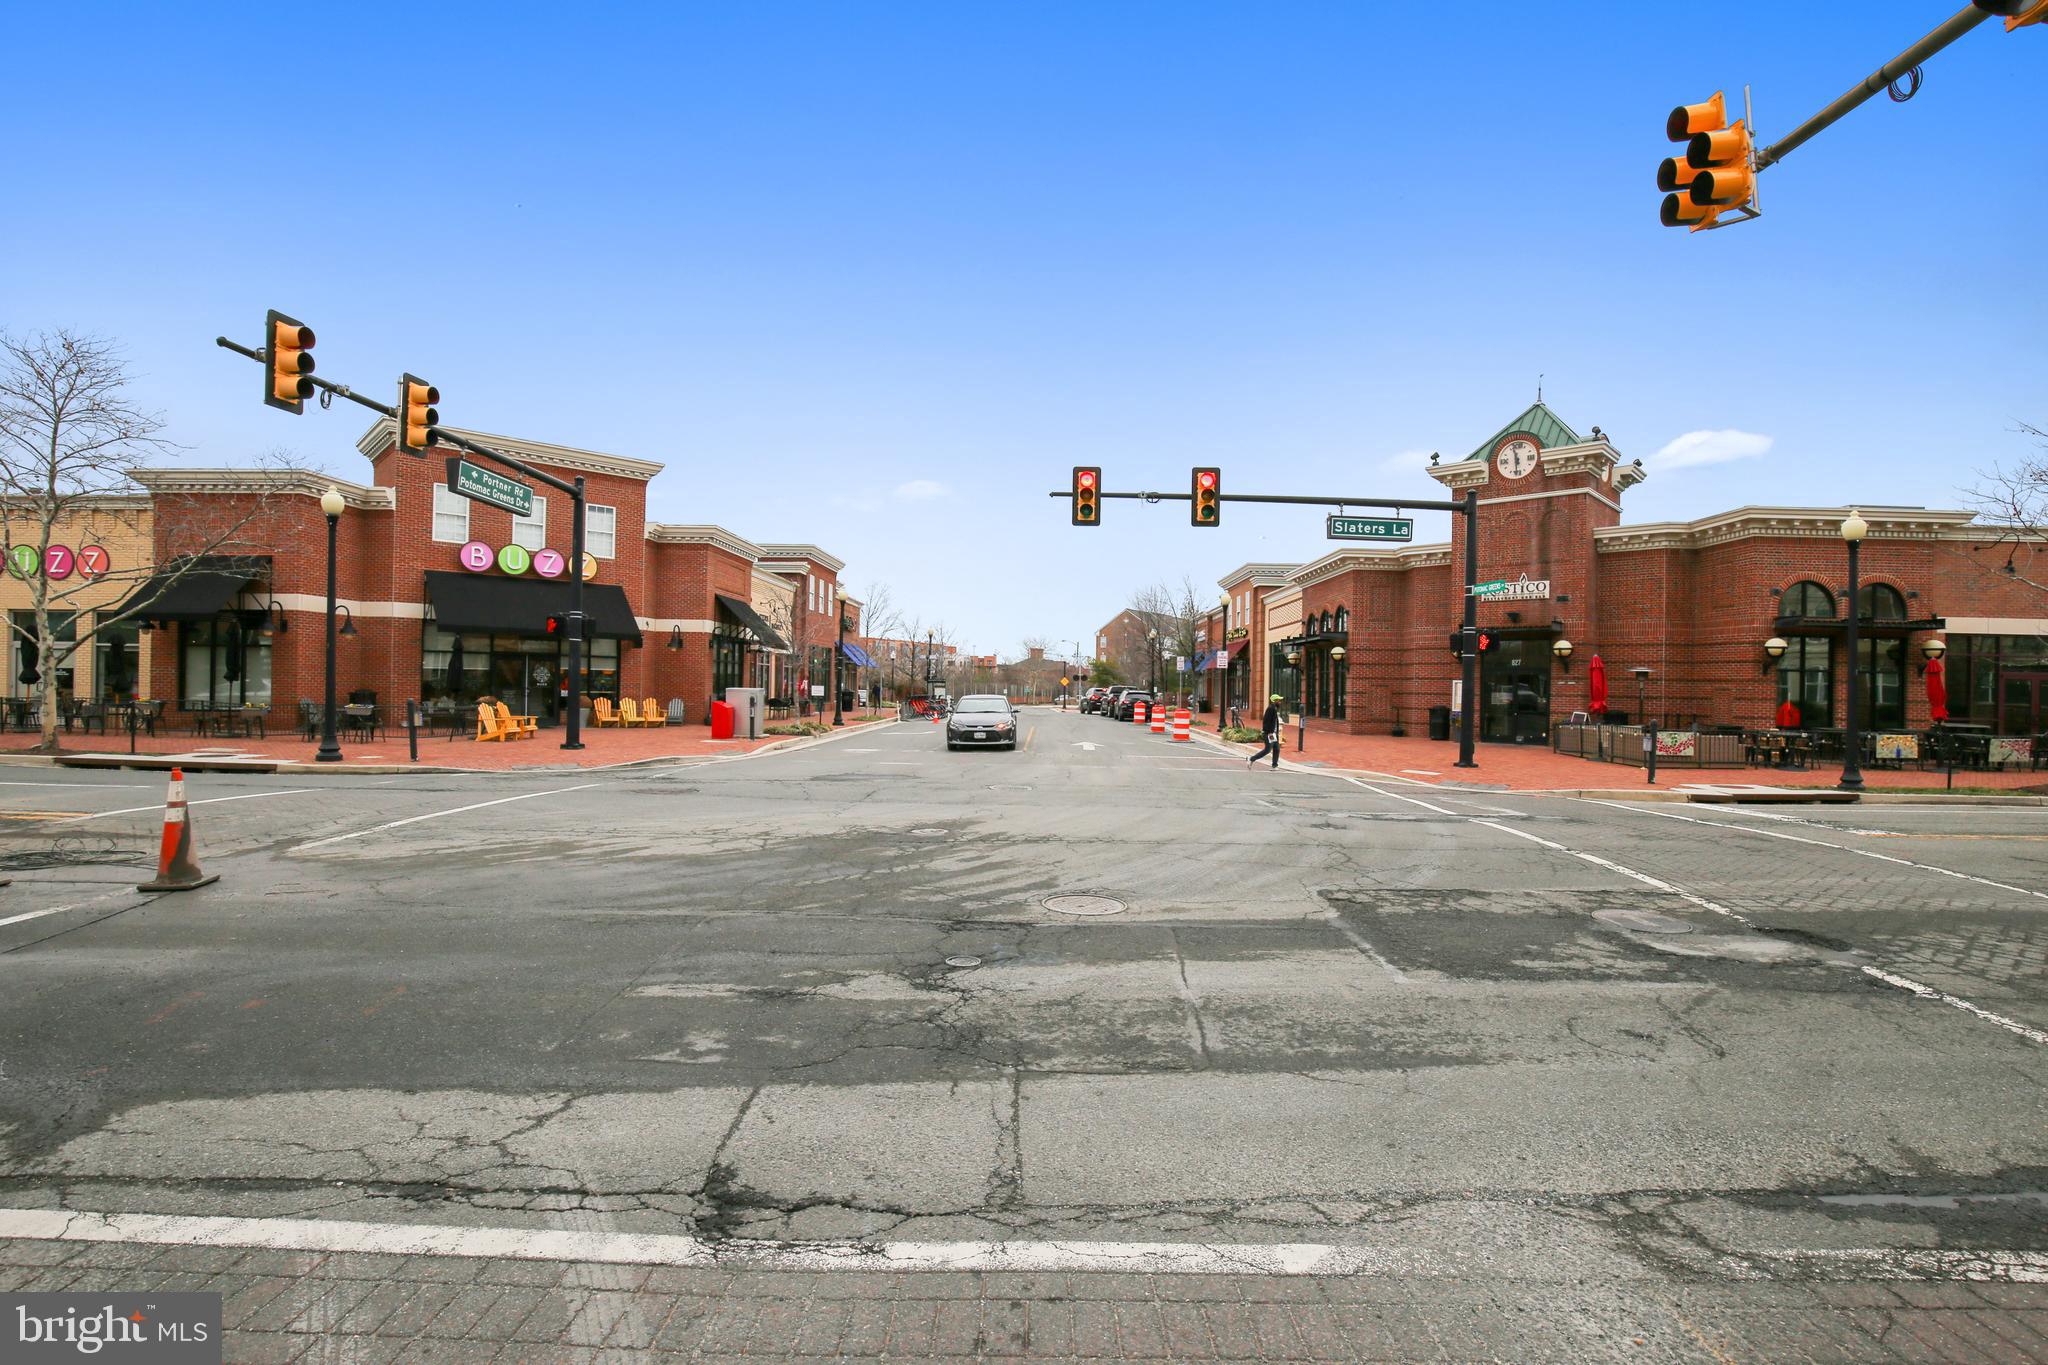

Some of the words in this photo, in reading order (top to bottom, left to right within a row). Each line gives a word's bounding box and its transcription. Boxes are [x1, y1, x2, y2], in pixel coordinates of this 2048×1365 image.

[460, 477, 490, 495] Potomac
[492, 490, 514, 504] Greens
[516, 498, 523, 507] Dr
[483, 473, 511, 492] Portner
[514, 487, 524, 497] Rd
[1335, 522, 1385, 534] Slaters
[1392, 524, 1408, 534] La
